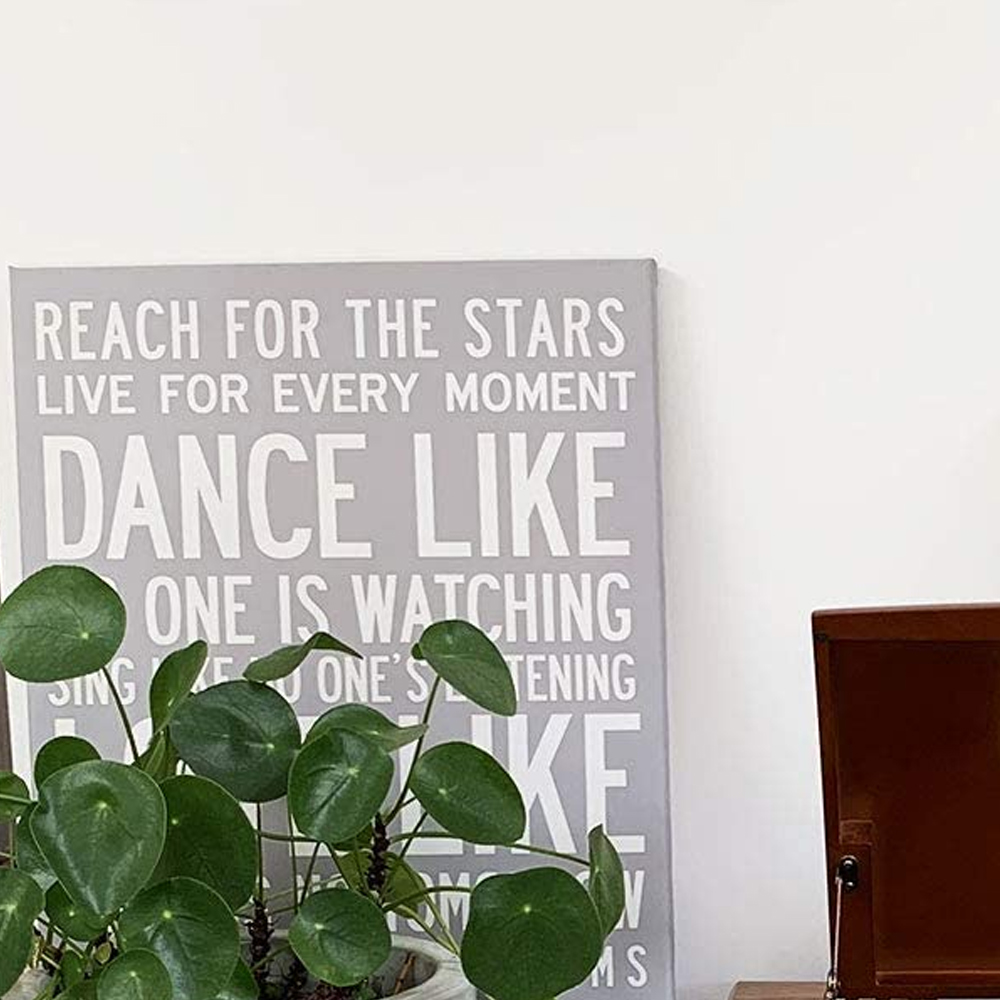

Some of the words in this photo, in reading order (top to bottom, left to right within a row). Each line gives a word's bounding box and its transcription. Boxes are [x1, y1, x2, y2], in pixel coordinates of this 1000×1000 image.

[34, 300, 200, 361] REACH
[226, 299, 320, 360] FOR
[345, 298, 439, 359] THE
[463, 297, 625, 358] STARS
[37, 374, 136, 415] LIVE
[160, 373, 249, 414] FOR
[272, 372, 420, 413] EVERY
[445, 371, 636, 412] MOMENT
[42, 433, 373, 560] DANCE
[413, 431, 631, 558] LIKE
[145, 575, 255, 645] ONE
[278, 574, 330, 644] IS
[351, 571, 632, 644] WATCHING
[316, 653, 431, 703] ONE'S
